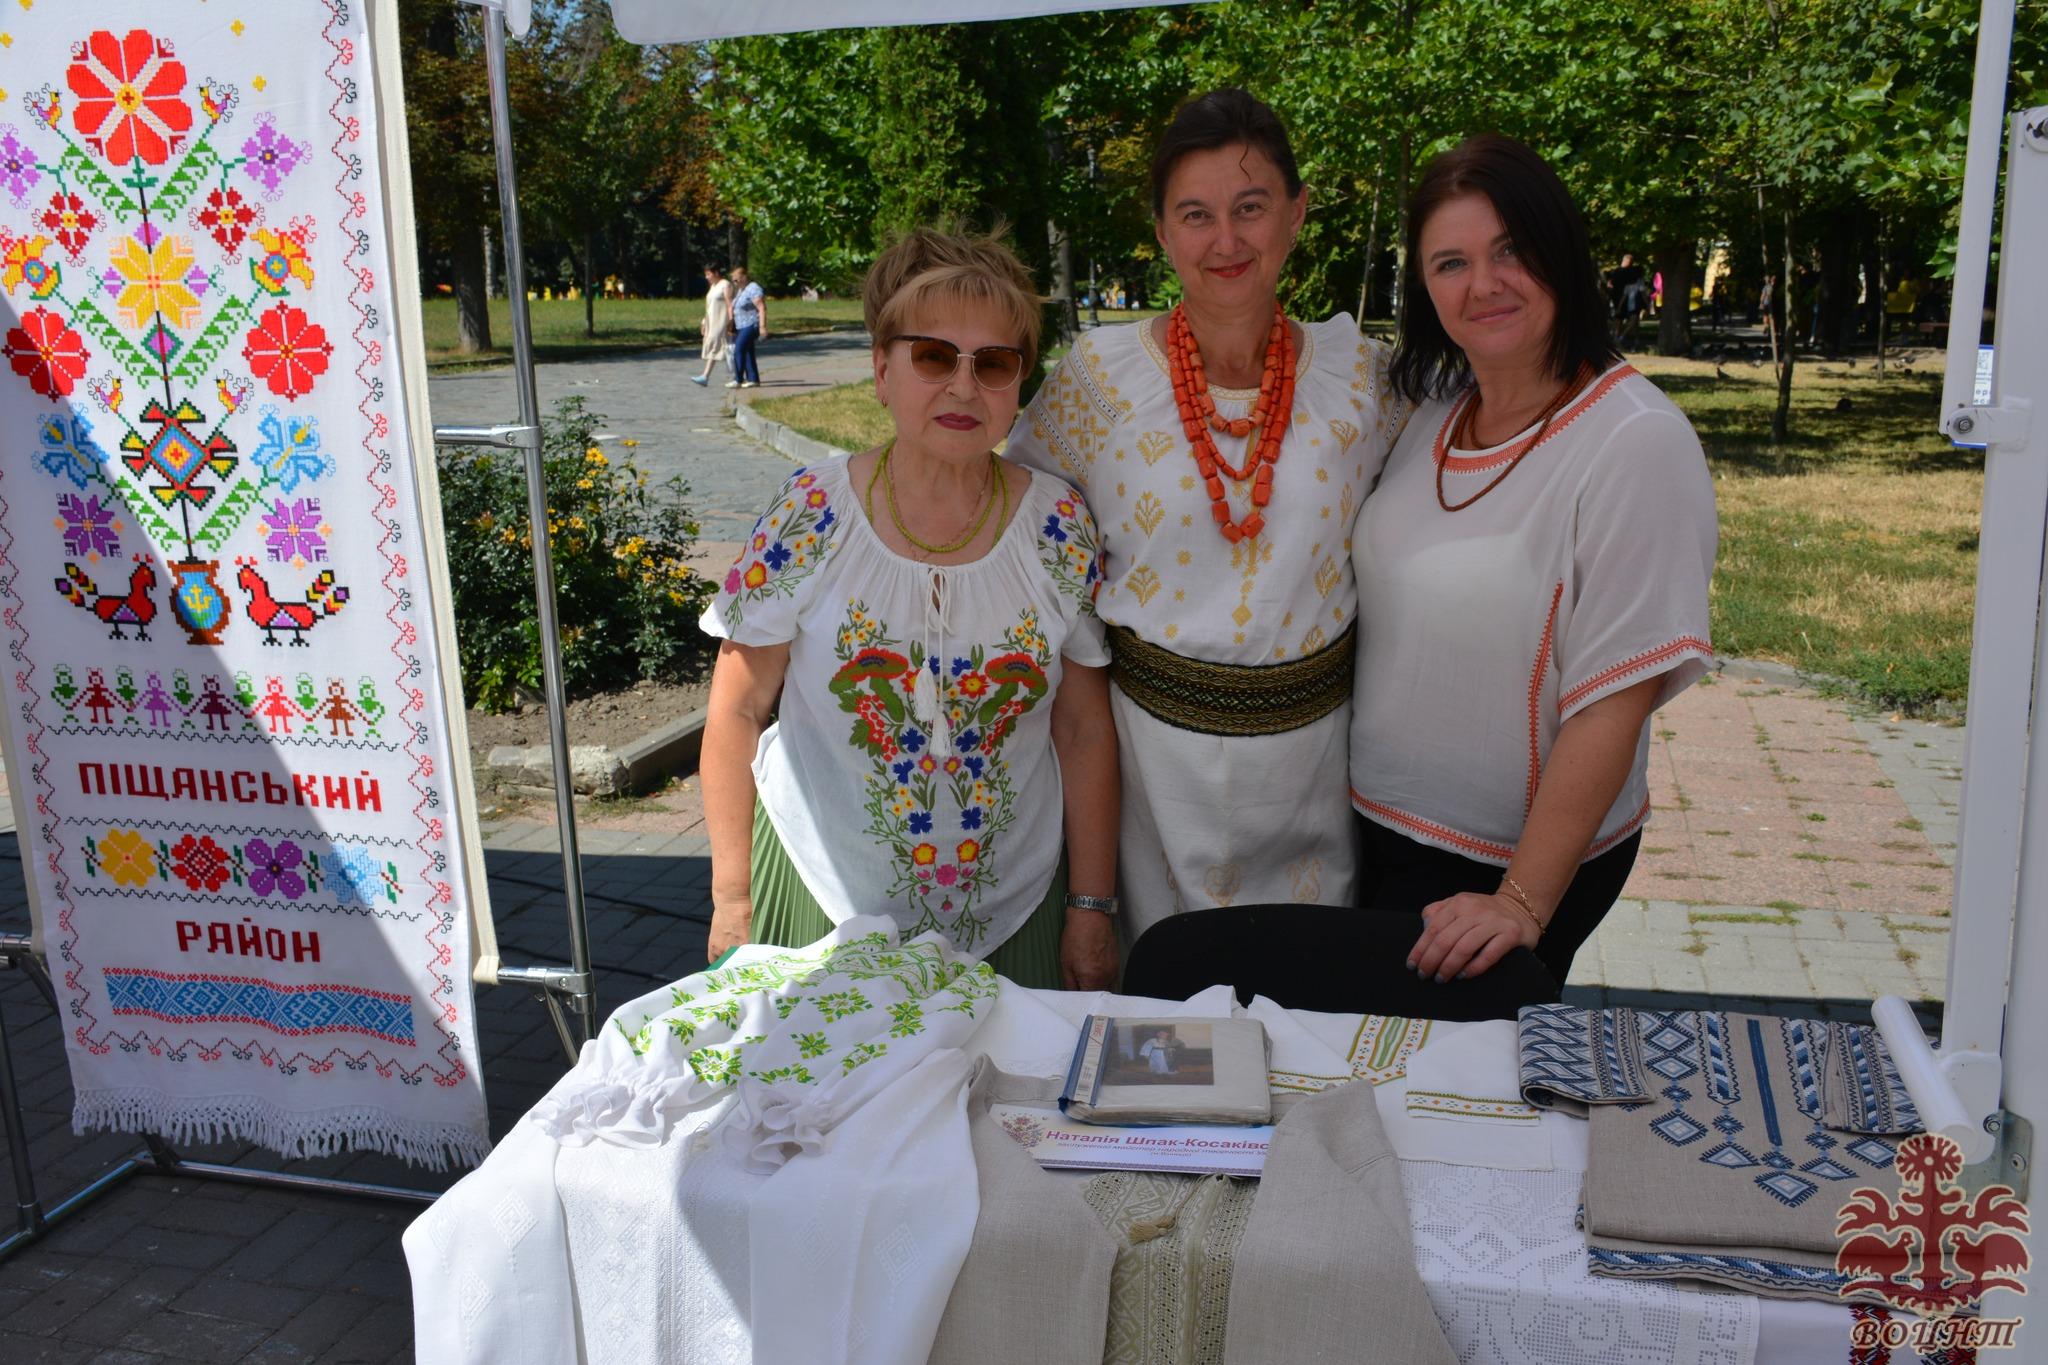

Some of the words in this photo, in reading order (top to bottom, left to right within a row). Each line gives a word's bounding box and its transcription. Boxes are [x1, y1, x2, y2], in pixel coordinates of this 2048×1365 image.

[79, 762, 382, 812] ПІЩАНСЬКИЙ
[176, 917, 321, 963] РАЙОН
[1046, 1130, 1120, 1144] Наталія
